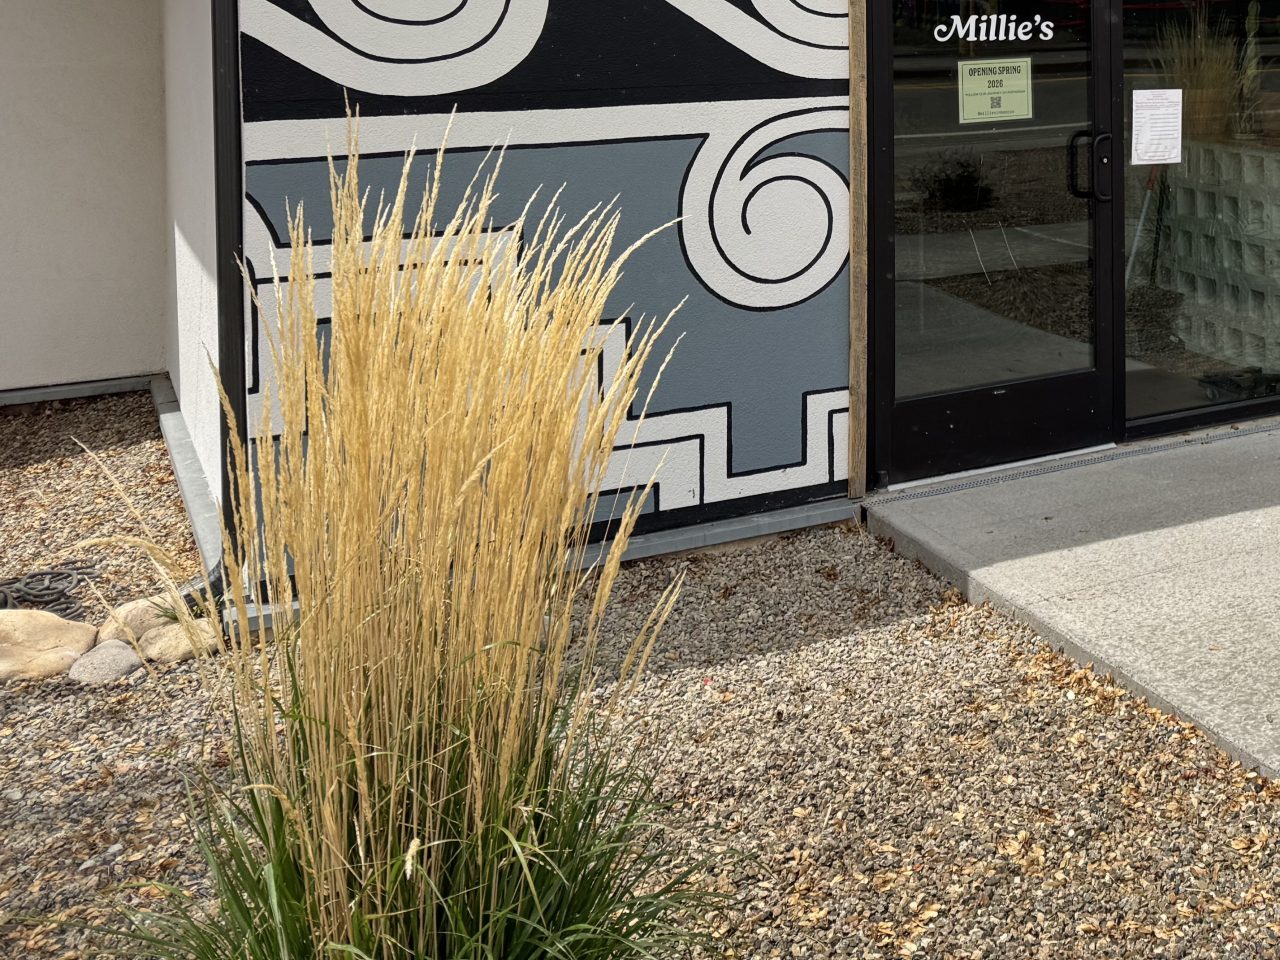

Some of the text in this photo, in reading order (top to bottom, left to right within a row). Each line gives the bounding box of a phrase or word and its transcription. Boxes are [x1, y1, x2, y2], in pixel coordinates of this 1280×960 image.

[934, 14, 1054, 42] Millie's
[968, 65, 1021, 77] OPENING SPRING
[987, 79, 1004, 89] 2026
